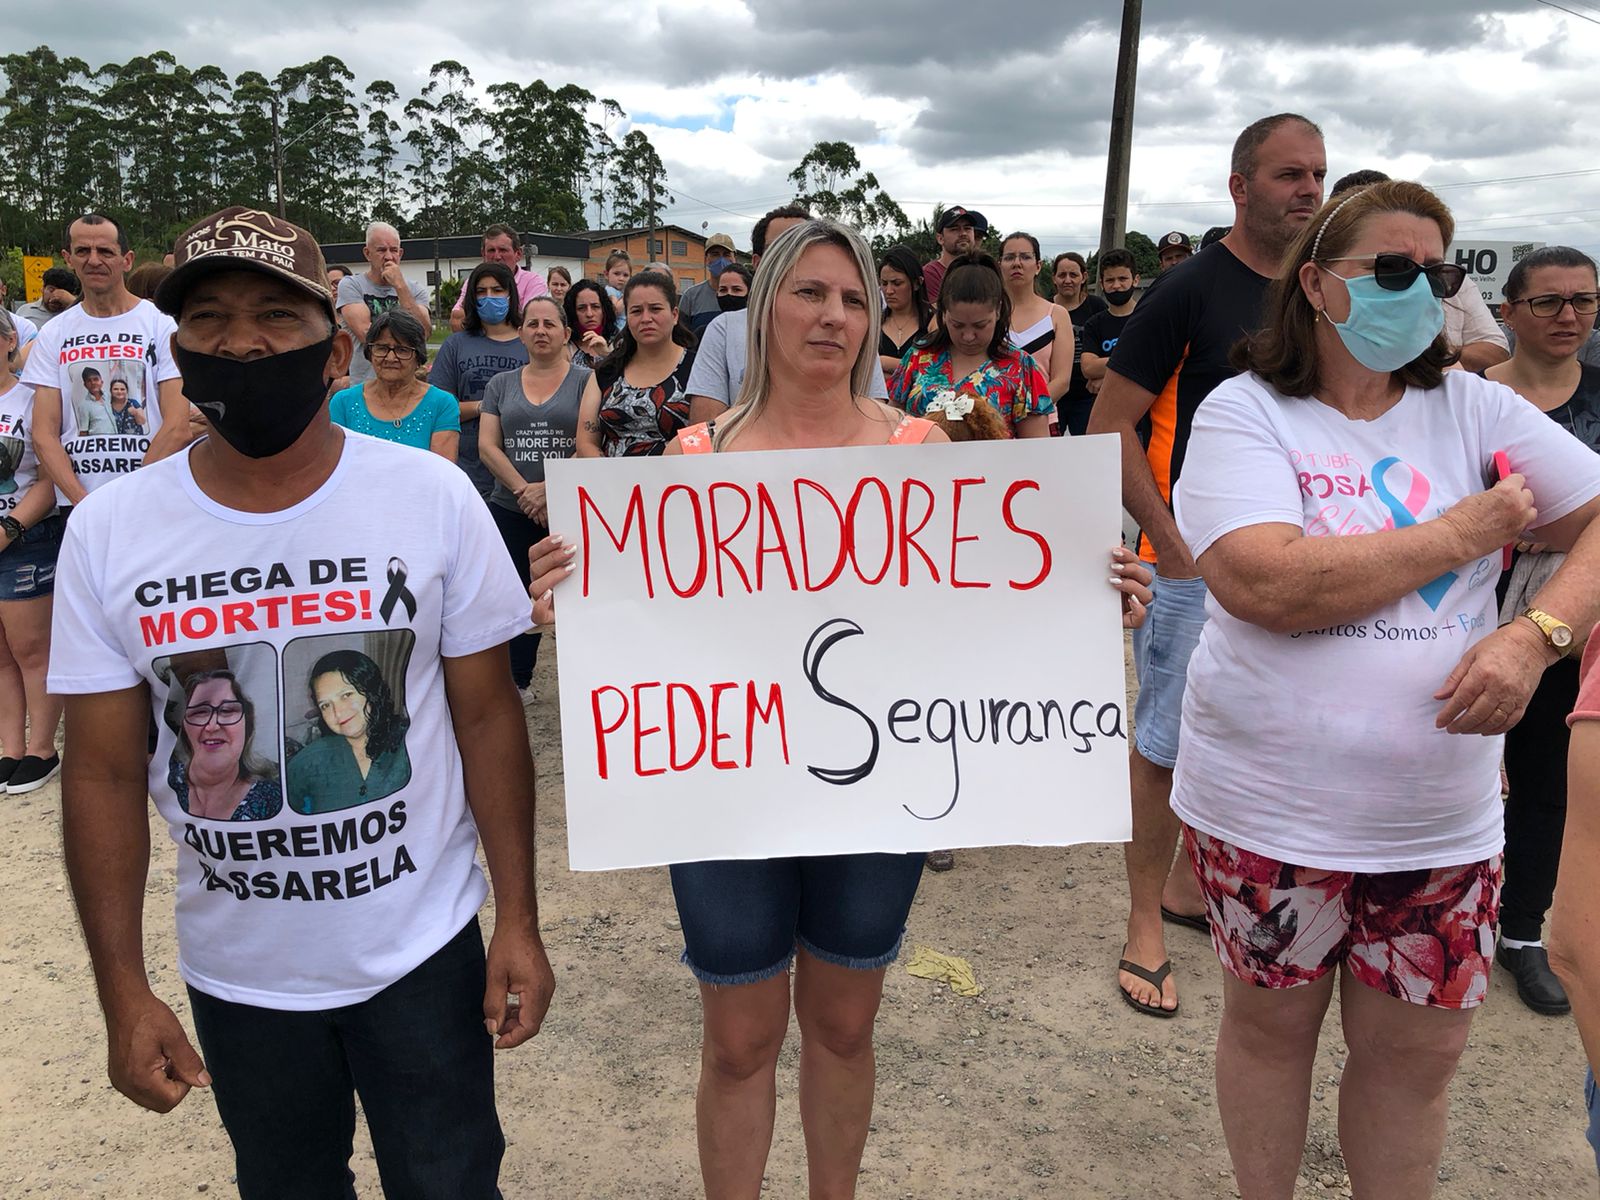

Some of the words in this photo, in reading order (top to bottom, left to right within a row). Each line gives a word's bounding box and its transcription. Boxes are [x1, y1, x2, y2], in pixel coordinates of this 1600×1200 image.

[185, 239, 217, 262] Du
[231, 230, 296, 257] Mato
[260, 252, 268, 260] A
[61, 334, 111, 349] HEGA
[118, 333, 143, 344] DE
[64, 438, 151, 454] QUEREMO
[515, 451, 539, 462] LIKE
[541, 451, 565, 460] YOU
[517, 437, 549, 448] MORE
[577, 476, 1053, 598] MORADORES
[134, 562, 295, 608] CHEGA
[308, 557, 369, 586] DE
[139, 589, 373, 648] MORTES!
[1374, 620, 1438, 642] Somos
[590, 680, 790, 779] PEDEM
[802, 617, 1128, 821] Segurança
[184, 800, 407, 861] QUEREMOS
[199, 844, 417, 902] PASSARELA
